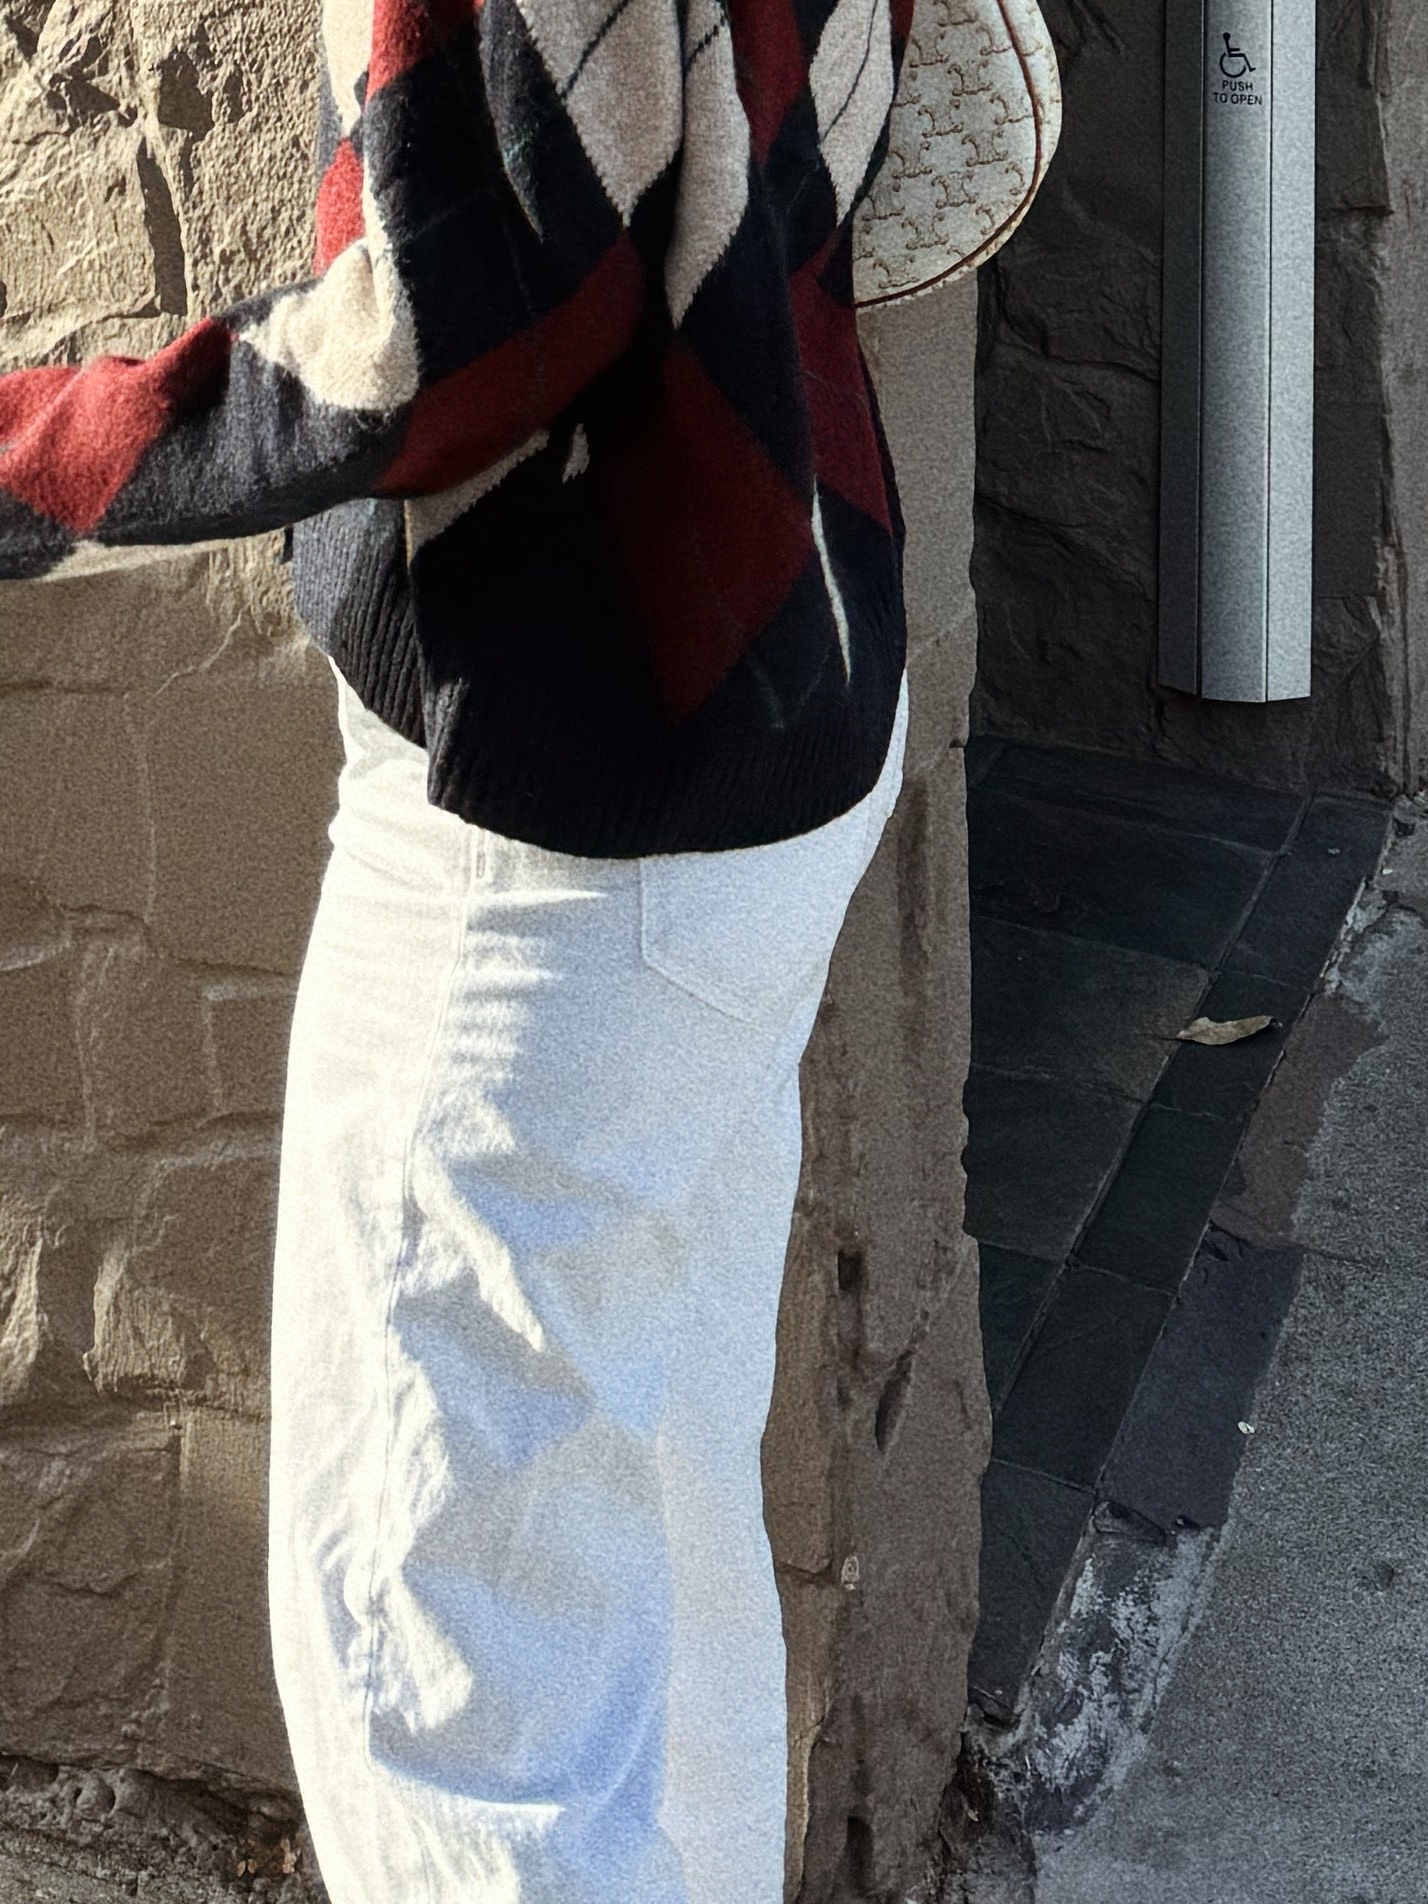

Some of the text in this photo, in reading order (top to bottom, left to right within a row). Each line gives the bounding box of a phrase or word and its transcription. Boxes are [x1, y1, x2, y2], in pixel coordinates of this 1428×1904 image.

[1222, 79, 1253, 92] PUSH
[1213, 92, 1263, 106] TO OPEN
